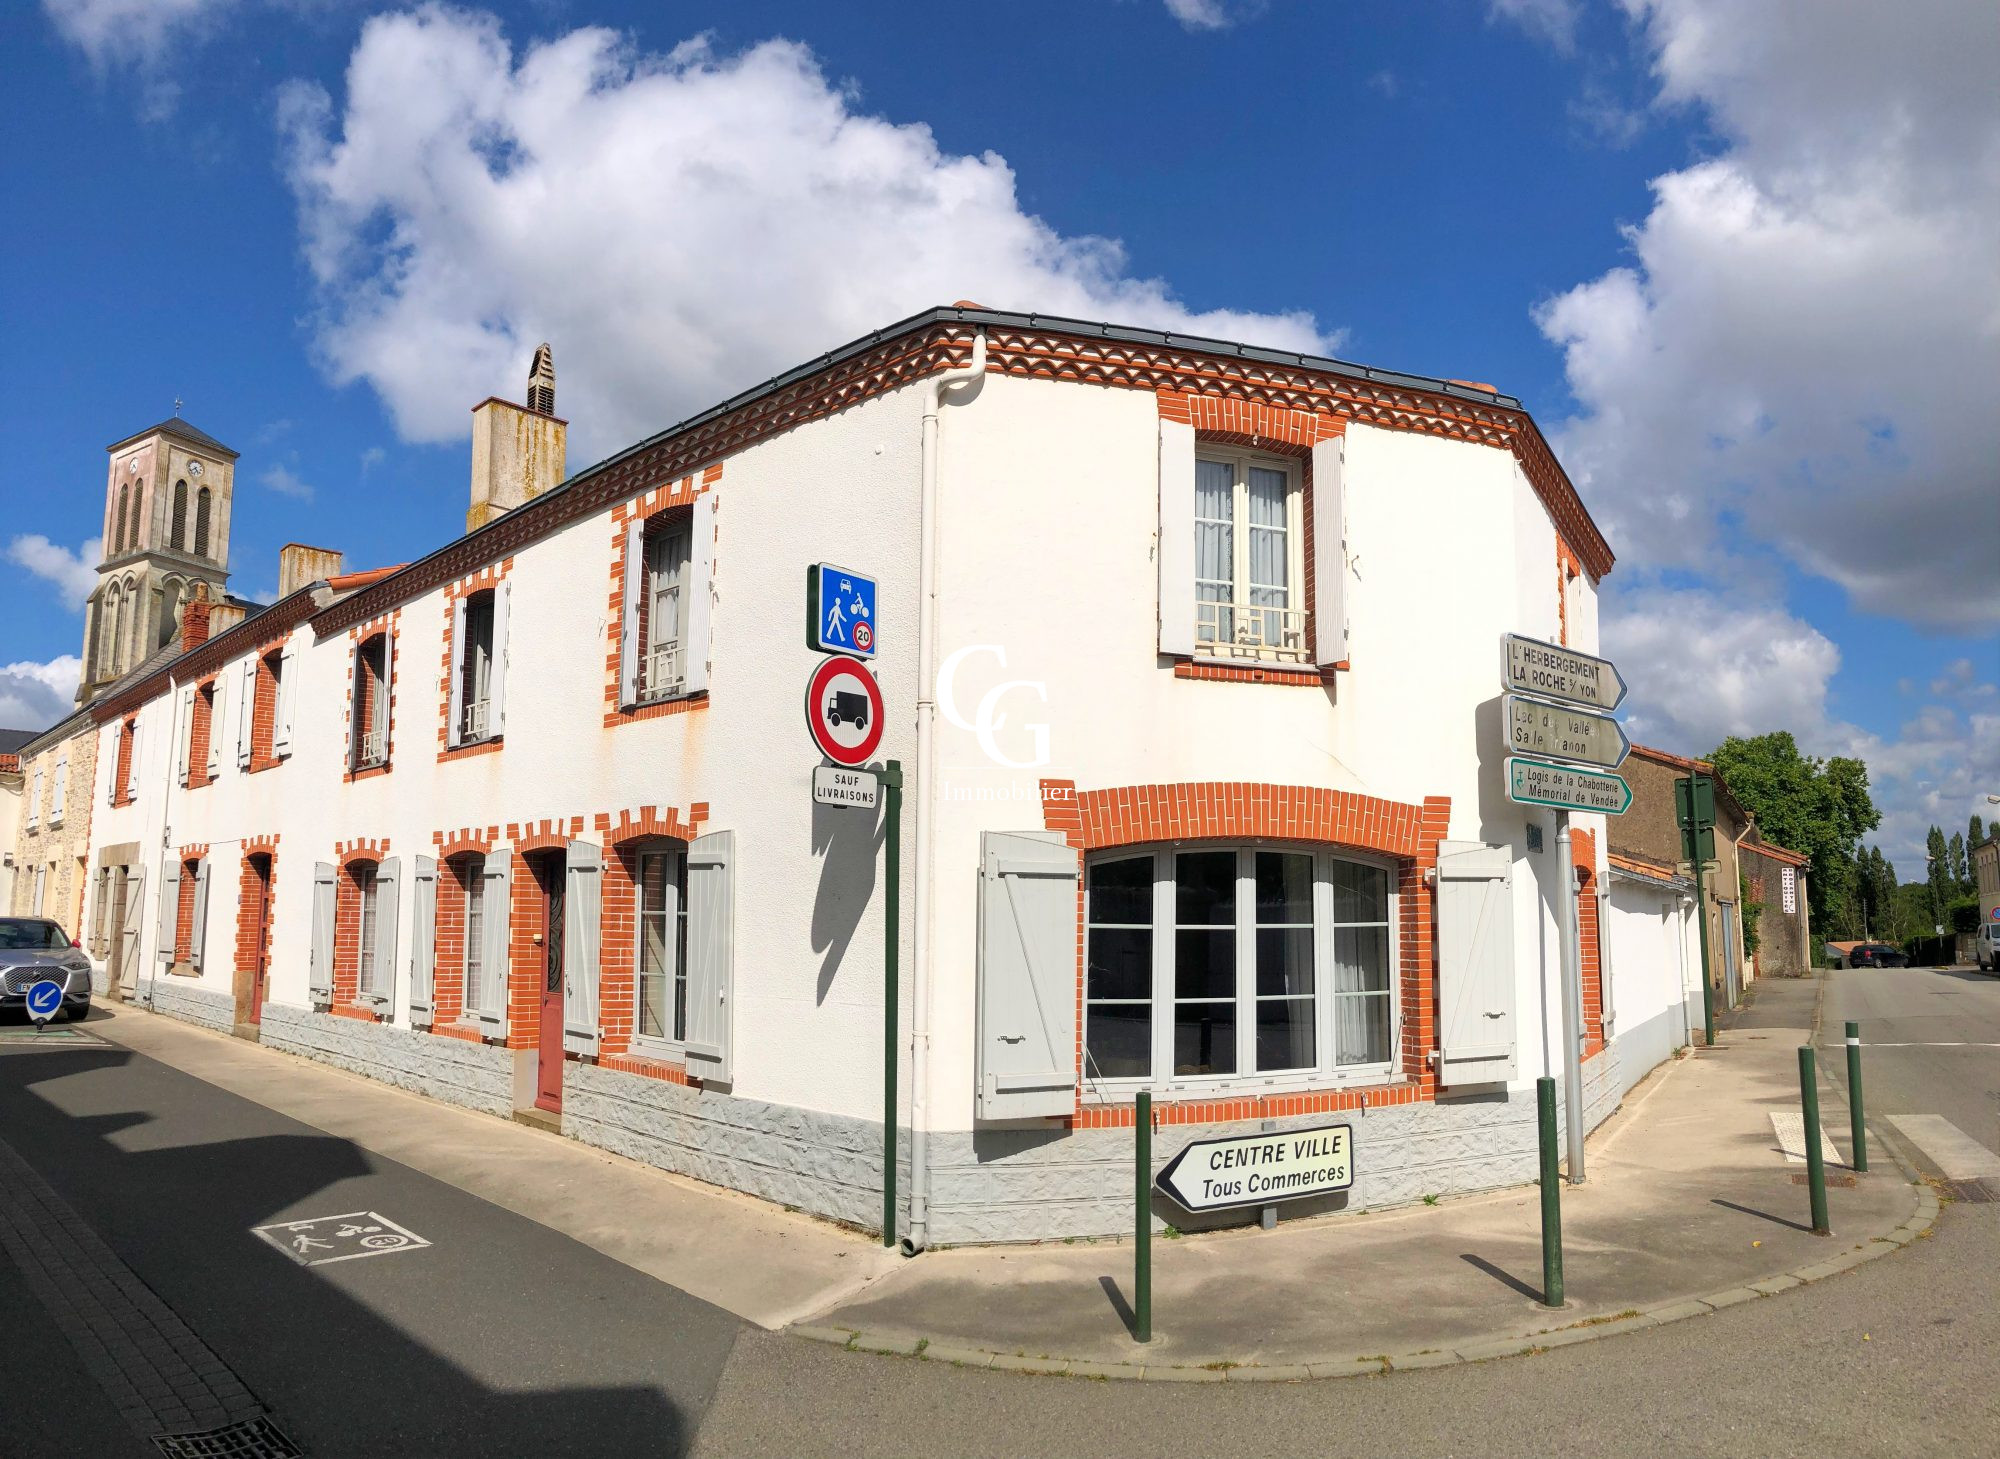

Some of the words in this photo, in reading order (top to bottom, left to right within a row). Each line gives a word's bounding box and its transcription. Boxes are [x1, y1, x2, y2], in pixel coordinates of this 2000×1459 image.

[857, 629, 869, 643] 20
[1512, 643, 1600, 682] L'HERBERGEMENT
[1513, 665, 1526, 682] LA
[1532, 670, 1566, 692] ROCHE
[1580, 685, 1596, 699] YON
[1515, 706, 1533, 725] Lac
[835, 774, 859, 787] SAUF
[1527, 768, 1549, 785] Logis
[1553, 772, 1563, 784] de
[1566, 774, 1574, 787] la
[1577, 776, 1619, 793] Chabotterie
[817, 787, 874, 803] LIVRAISONS
[1528, 783, 1571, 802] Mémorial
[1575, 791, 1585, 804] de
[1590, 792, 1619, 808] Vendée
[1210, 1142, 1286, 1171] CENTRE
[1294, 1135, 1342, 1160] VILLE
[1203, 1179, 1242, 1199] Tous
[1248, 1165, 1345, 1193] Commerces
[371, 1238, 399, 1246] 20
